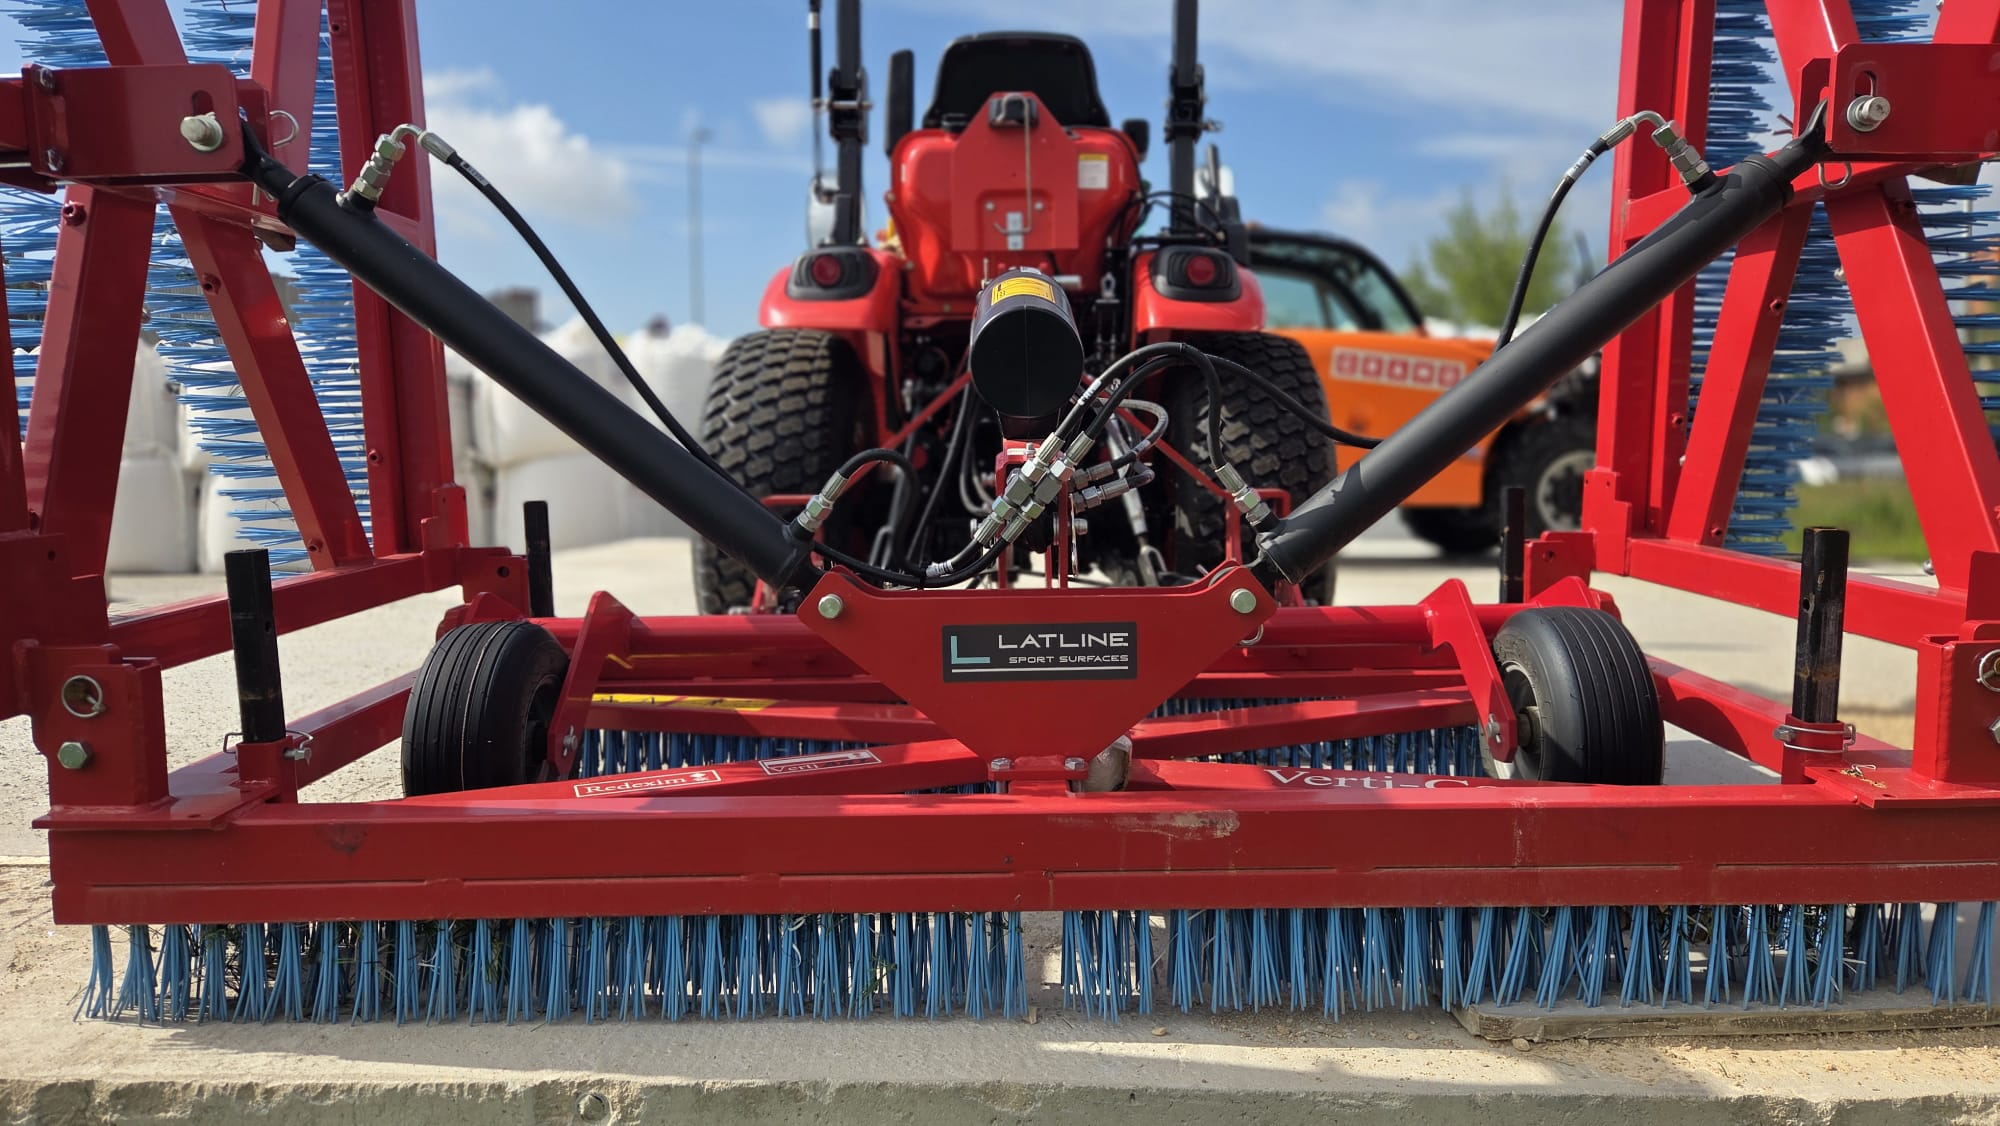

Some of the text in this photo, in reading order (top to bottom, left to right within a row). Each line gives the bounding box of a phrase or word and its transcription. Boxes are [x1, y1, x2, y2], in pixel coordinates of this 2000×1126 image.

[998, 632, 1129, 649] LATLINE
[1008, 654, 1129, 664] SPORT SURFACES
[585, 777, 687, 793] Redexim
